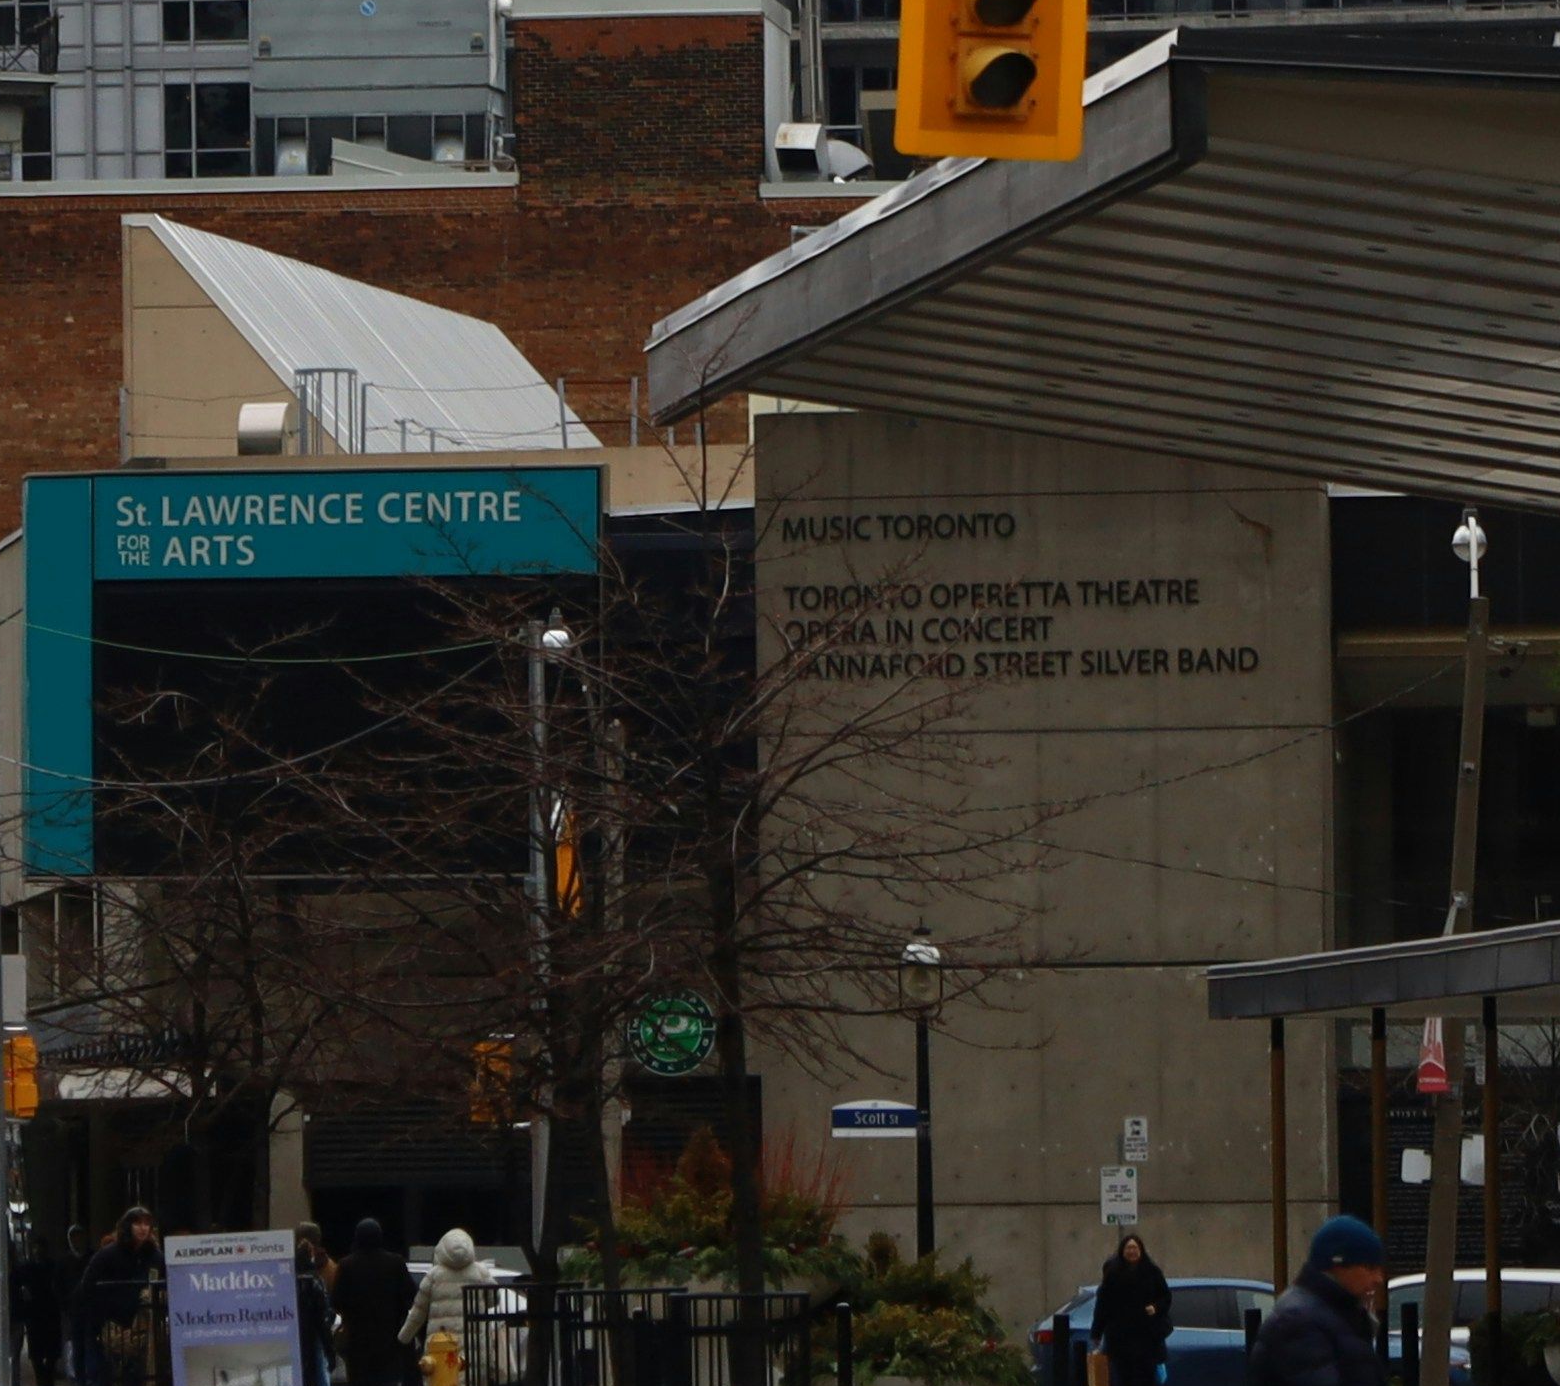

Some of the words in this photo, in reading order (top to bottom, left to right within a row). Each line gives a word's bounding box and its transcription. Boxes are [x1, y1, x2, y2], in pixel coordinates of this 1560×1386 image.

[116, 494, 152, 527] St.
[161, 492, 365, 527] LAWRENCE
[377, 490, 522, 524] CENTRE
[782, 516, 871, 542] MUSIC
[878, 513, 1016, 541] TORONTO
[117, 534, 151, 551] FOR
[163, 534, 256, 567] ARTS
[118, 551, 151, 566] THE
[784, 583, 922, 612] TORONTO
[930, 580, 1071, 609] OPERETTA
[1077, 578, 1200, 605] THEATRE
[784, 618, 877, 646] OPERA
[885, 619, 913, 643] IN
[924, 616, 1053, 642] CONCERT
[973, 650, 1072, 678] STREET
[1080, 649, 1168, 676] SILVER
[1179, 647, 1259, 673] BAND
[854, 1110, 885, 1125] Scott
[250, 1243, 285, 1254] Points
[189, 1270, 275, 1292] Maddox
[174, 1309, 236, 1327] Modern
[238, 1305, 294, 1323] Rentals
